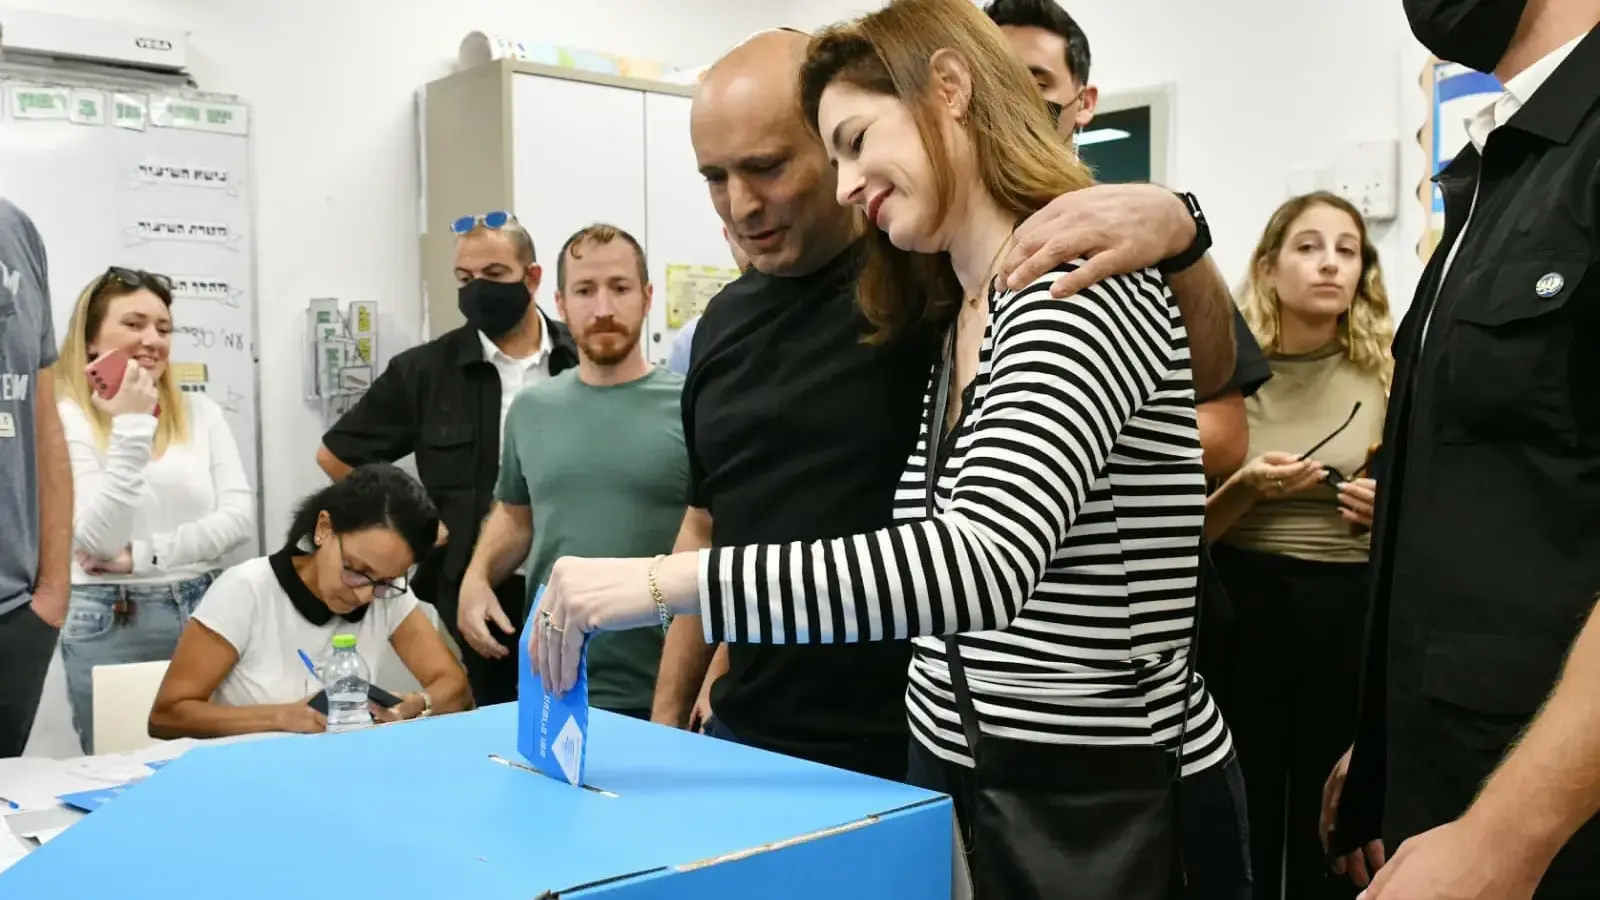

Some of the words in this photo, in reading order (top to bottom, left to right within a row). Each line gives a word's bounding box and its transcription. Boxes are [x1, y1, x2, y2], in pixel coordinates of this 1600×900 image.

[139, 164, 190, 180] השיעור
[193, 168, 227, 182] נושא
[138, 221, 185, 235] השיעור
[188, 224, 227, 237] מטרת
[0, 373, 29, 401] EM
